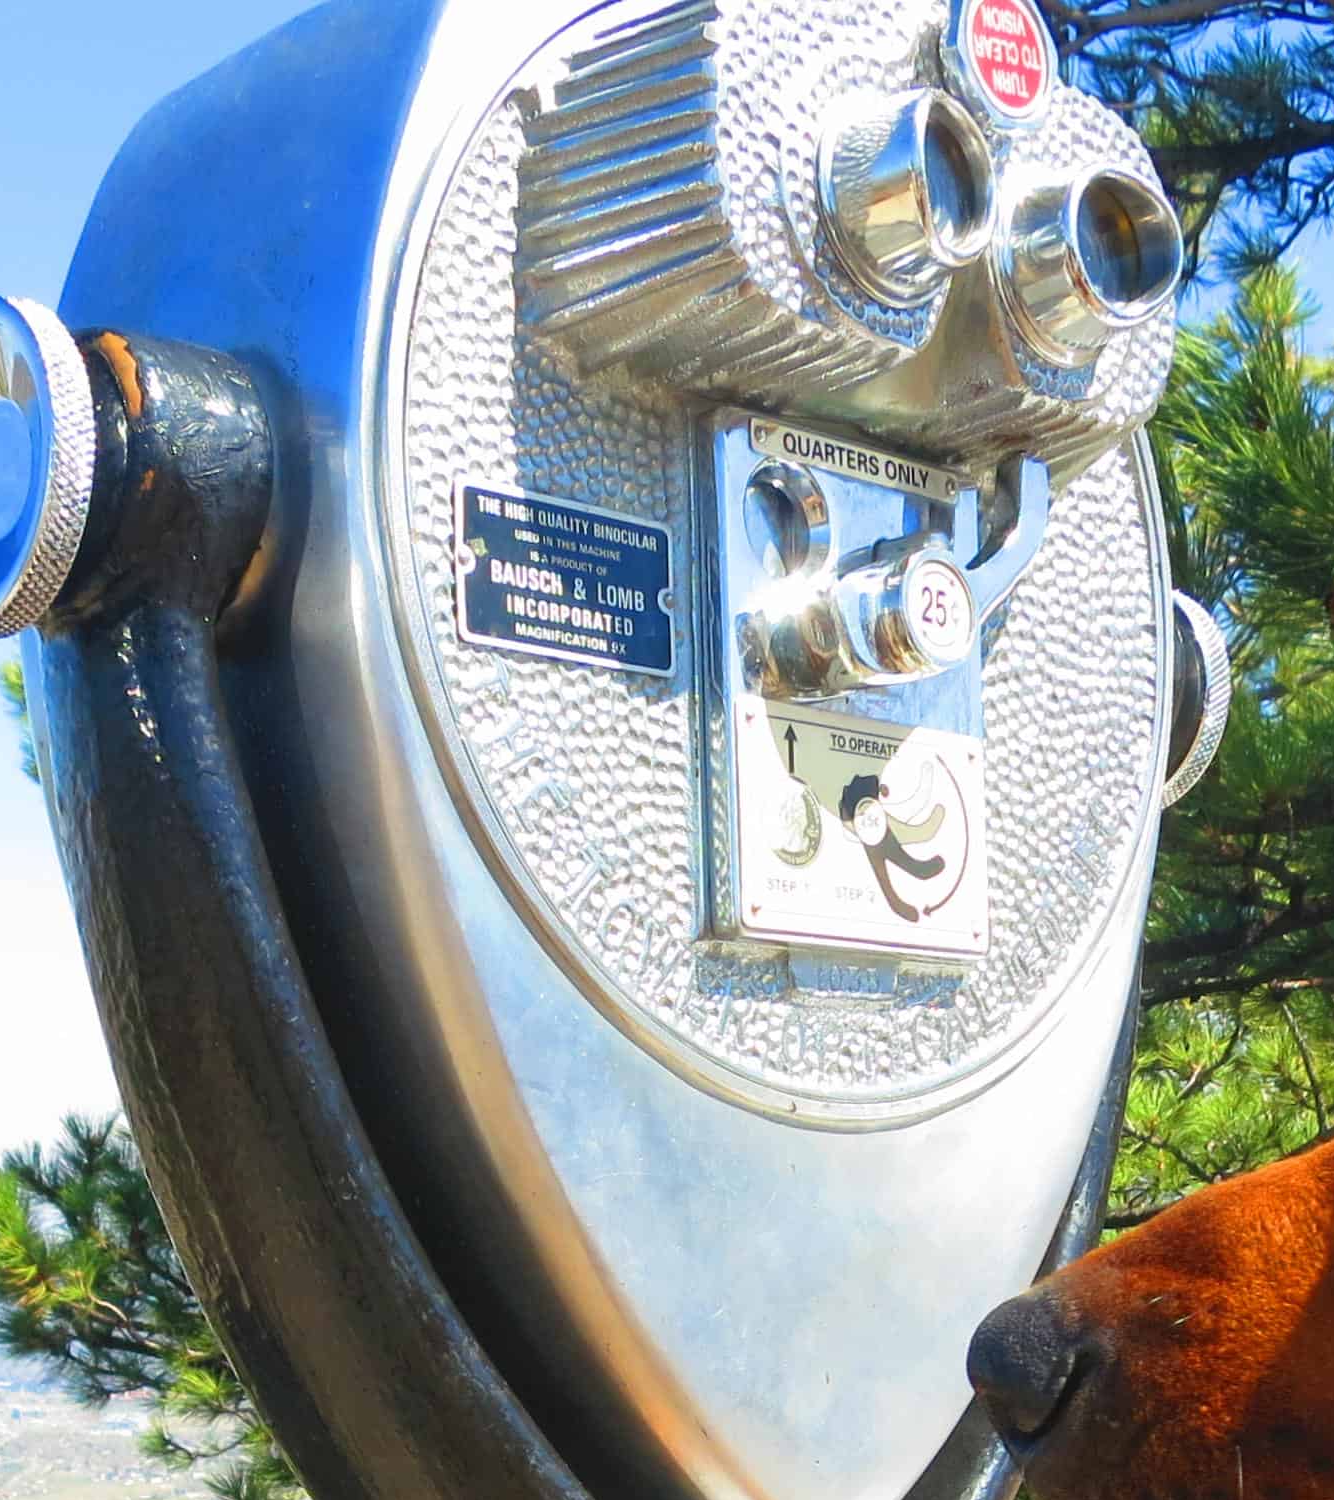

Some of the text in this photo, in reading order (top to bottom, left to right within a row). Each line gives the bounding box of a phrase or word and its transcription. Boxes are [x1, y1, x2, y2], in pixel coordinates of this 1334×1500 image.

[980, 4, 1027, 37] VISION
[973, 34, 1042, 71] TO CLEAR
[992, 68, 1030, 99] TURN
[782, 432, 931, 490] QUARTERS ONLY
[476, 495, 658, 552] THE HIGH QUALITY BINOCULAR
[514, 528, 622, 562] USED IN THIS MACHINE
[529, 551, 608, 577] IS A PRODUCT OF
[490, 558, 646, 613] BAUSCH & LOMB
[506, 593, 634, 637] INCORPORATED
[514, 622, 609, 653] MAGNIFICATION
[830, 733, 847, 749] TO
[766, 876, 797, 893] STEP
[834, 885, 864, 901] STEP
